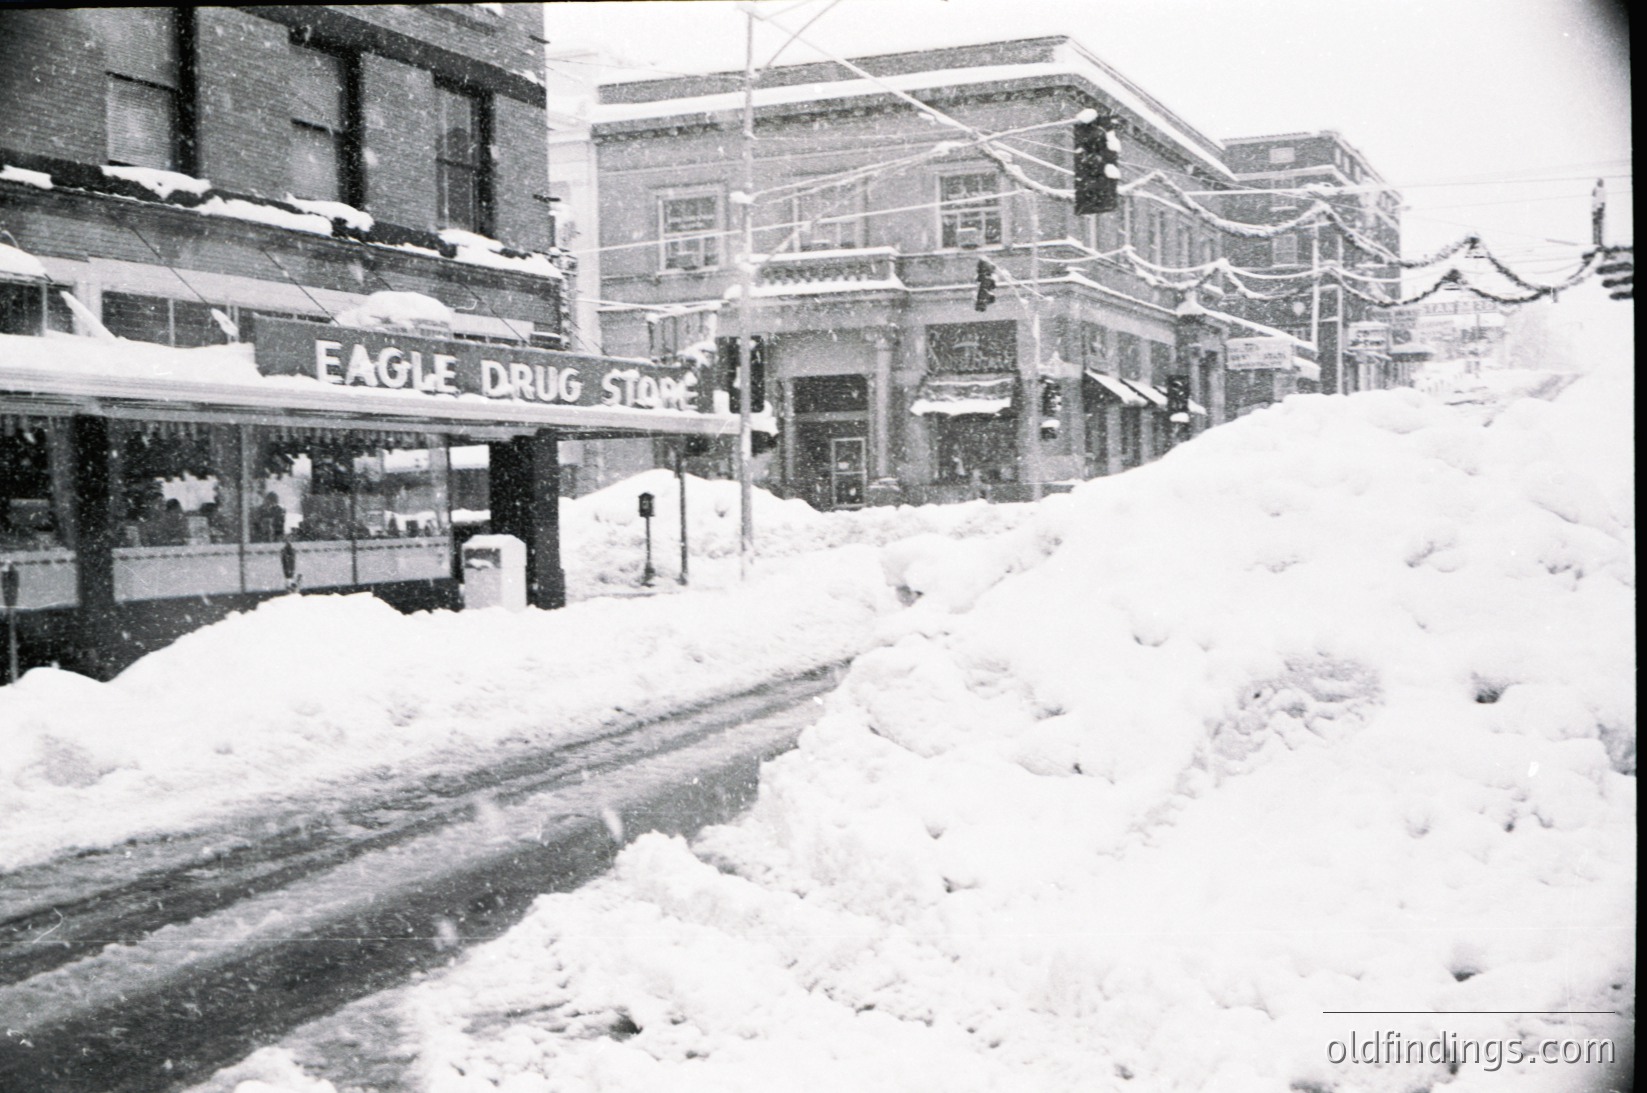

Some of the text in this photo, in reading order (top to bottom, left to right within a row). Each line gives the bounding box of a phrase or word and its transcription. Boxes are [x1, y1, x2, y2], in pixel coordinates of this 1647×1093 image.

[315, 339, 699, 411] EAGLE DRUG STORE
